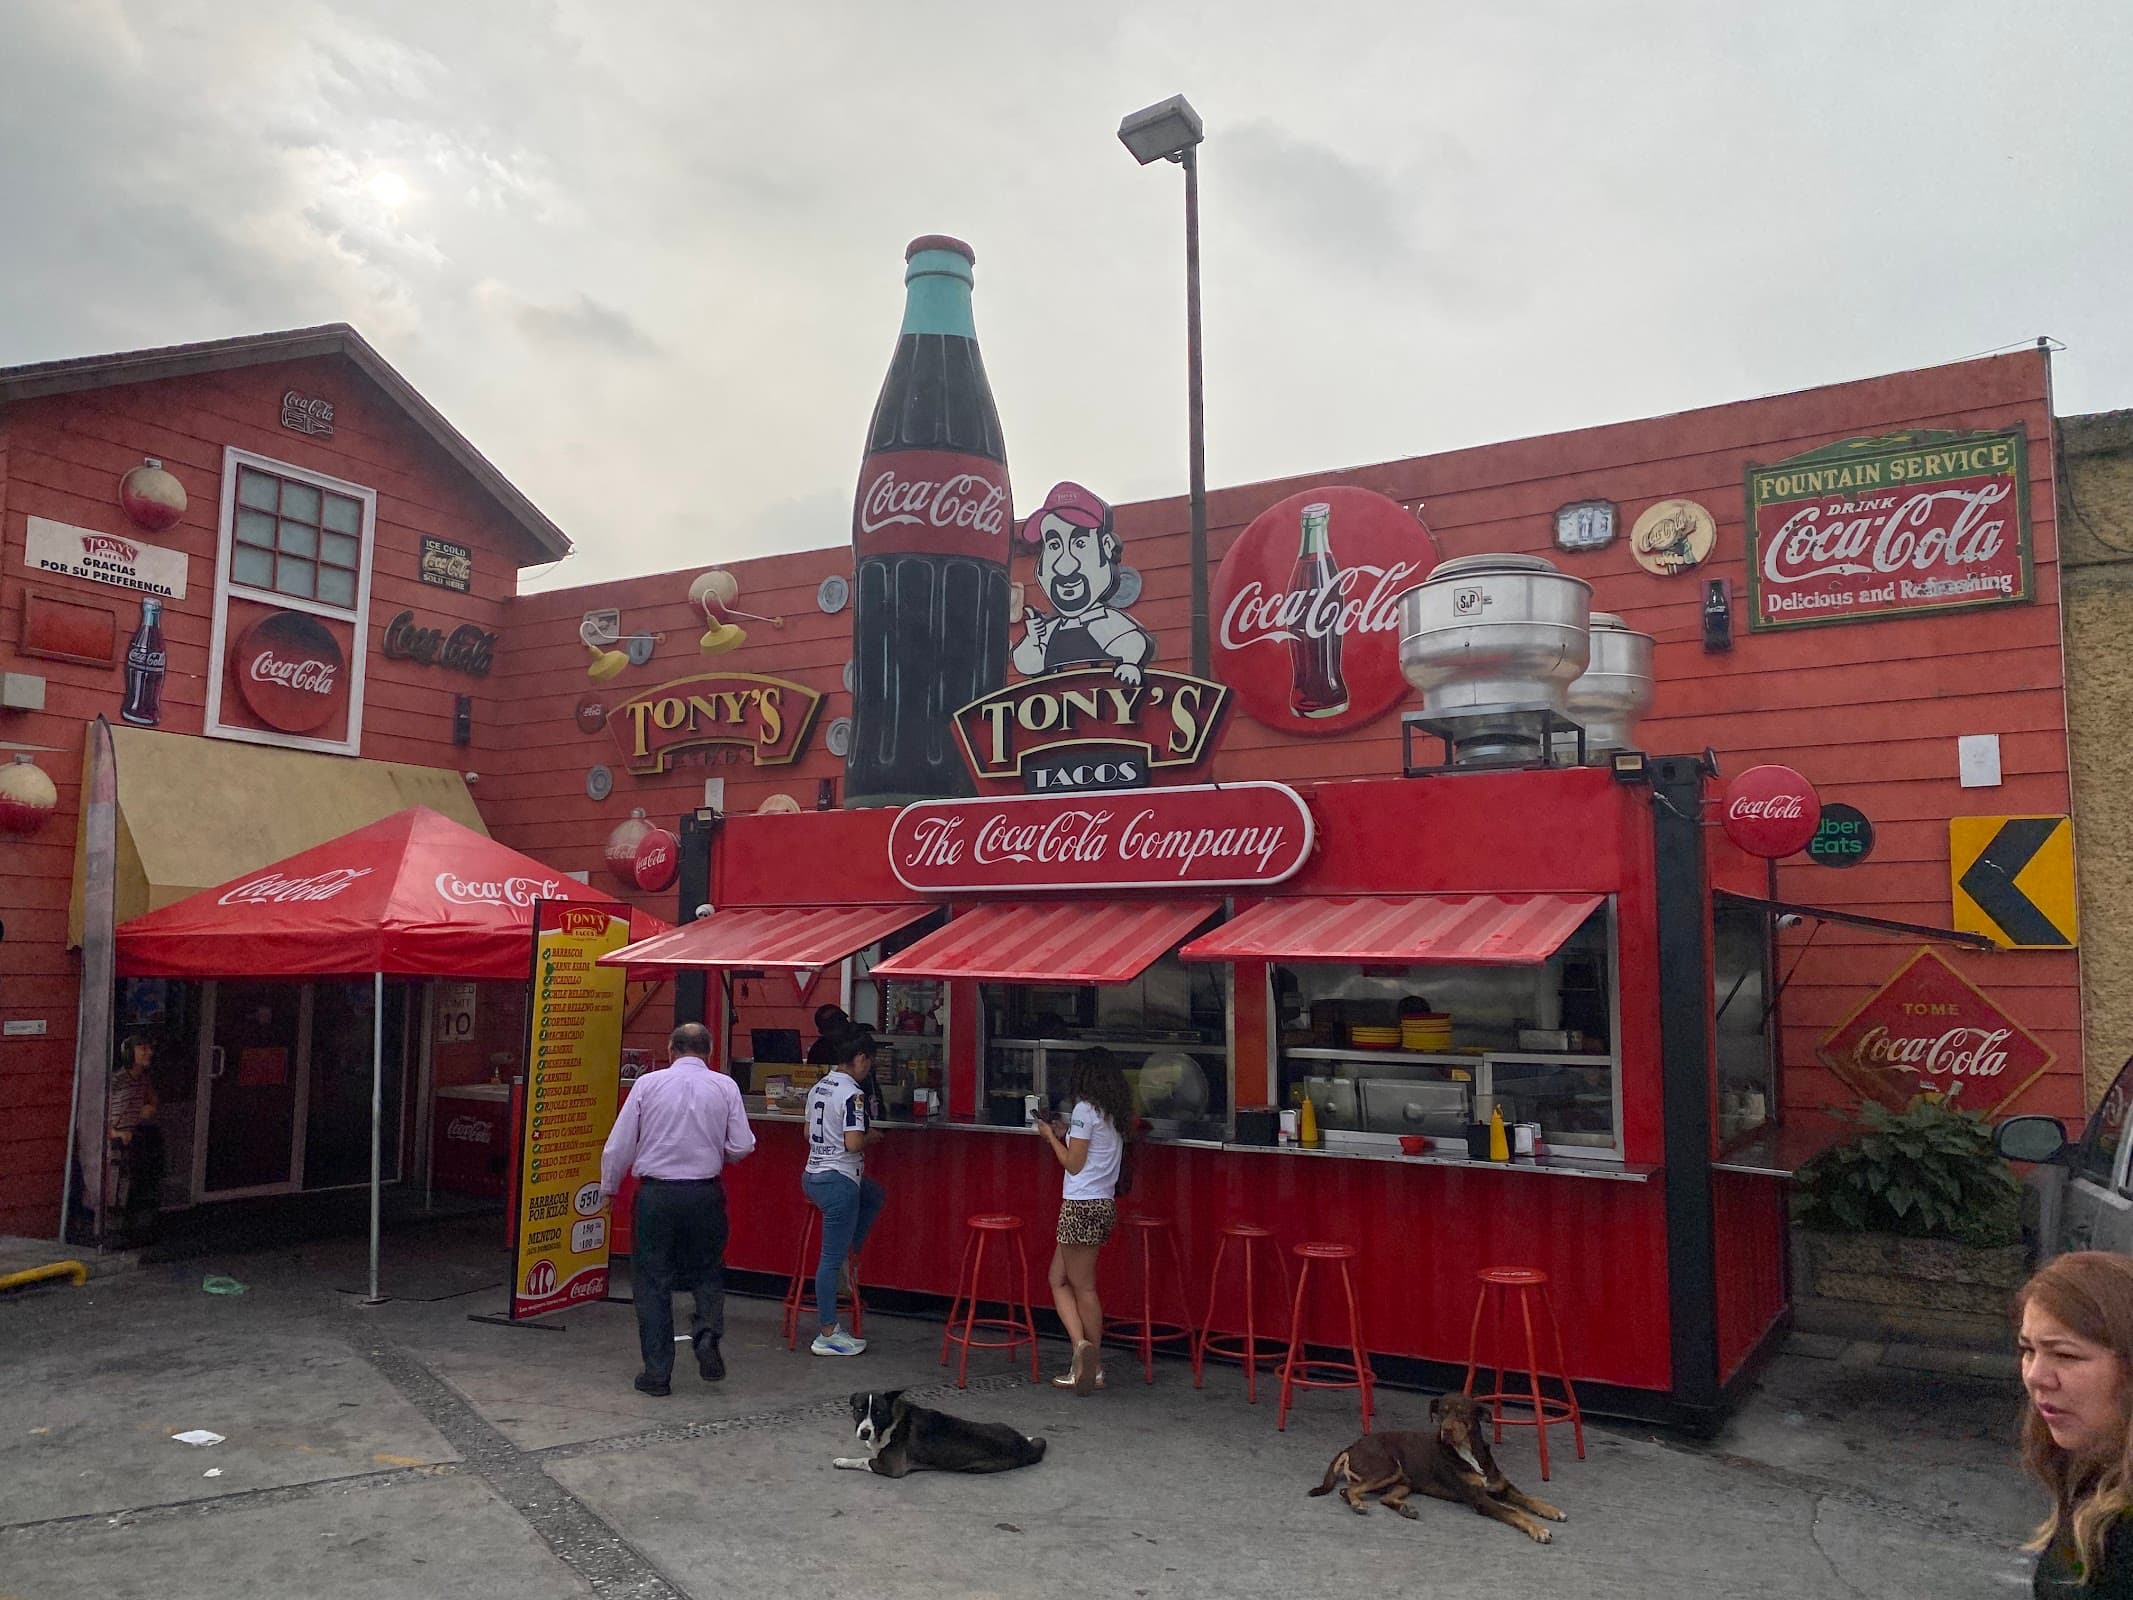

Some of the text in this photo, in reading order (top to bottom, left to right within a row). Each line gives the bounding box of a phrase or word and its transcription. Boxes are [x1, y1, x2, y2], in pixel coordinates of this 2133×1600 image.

[1761, 445, 2009, 499] FOUNTAIN SERVICE
[862, 471, 1006, 535] Coca-Cola
[1827, 497, 1897, 516] DRINK
[1764, 482, 2012, 583] Coca-Cola
[87, 537, 136, 563] TONY'S
[426, 540, 466, 556] ICE COLD
[40, 559, 172, 596] POR SU PREFERENCIA
[83, 557, 136, 576] GRACIAS
[423, 574, 443, 584] SOLD
[1220, 560, 1421, 650] Coca-Cola
[1768, 591, 1853, 612] Delicious
[1859, 581, 1895, 603] and
[250, 651, 337, 695] Coca-Cola
[626, 687, 782, 757] TONY'S
[981, 684, 1202, 764] TONY'S
[1031, 761, 1137, 788] TACOS
[1729, 795, 1805, 820] Coca-Cola
[905, 809, 1288, 876] The Coca-Cola Company
[1811, 837, 1863, 855] Eats
[566, 912, 605, 933] TONY'S
[1903, 1003, 1960, 1016] TOME
[444, 1012, 471, 1035] 10
[1856, 1026, 2013, 1076] Coca-Cola
[812, 1101, 825, 1143] 3
[528, 1204, 569, 1222] POR KILOS
[529, 1190, 599, 1210] BARBACOA 550
[527, 1228, 562, 1245] MENUDO
